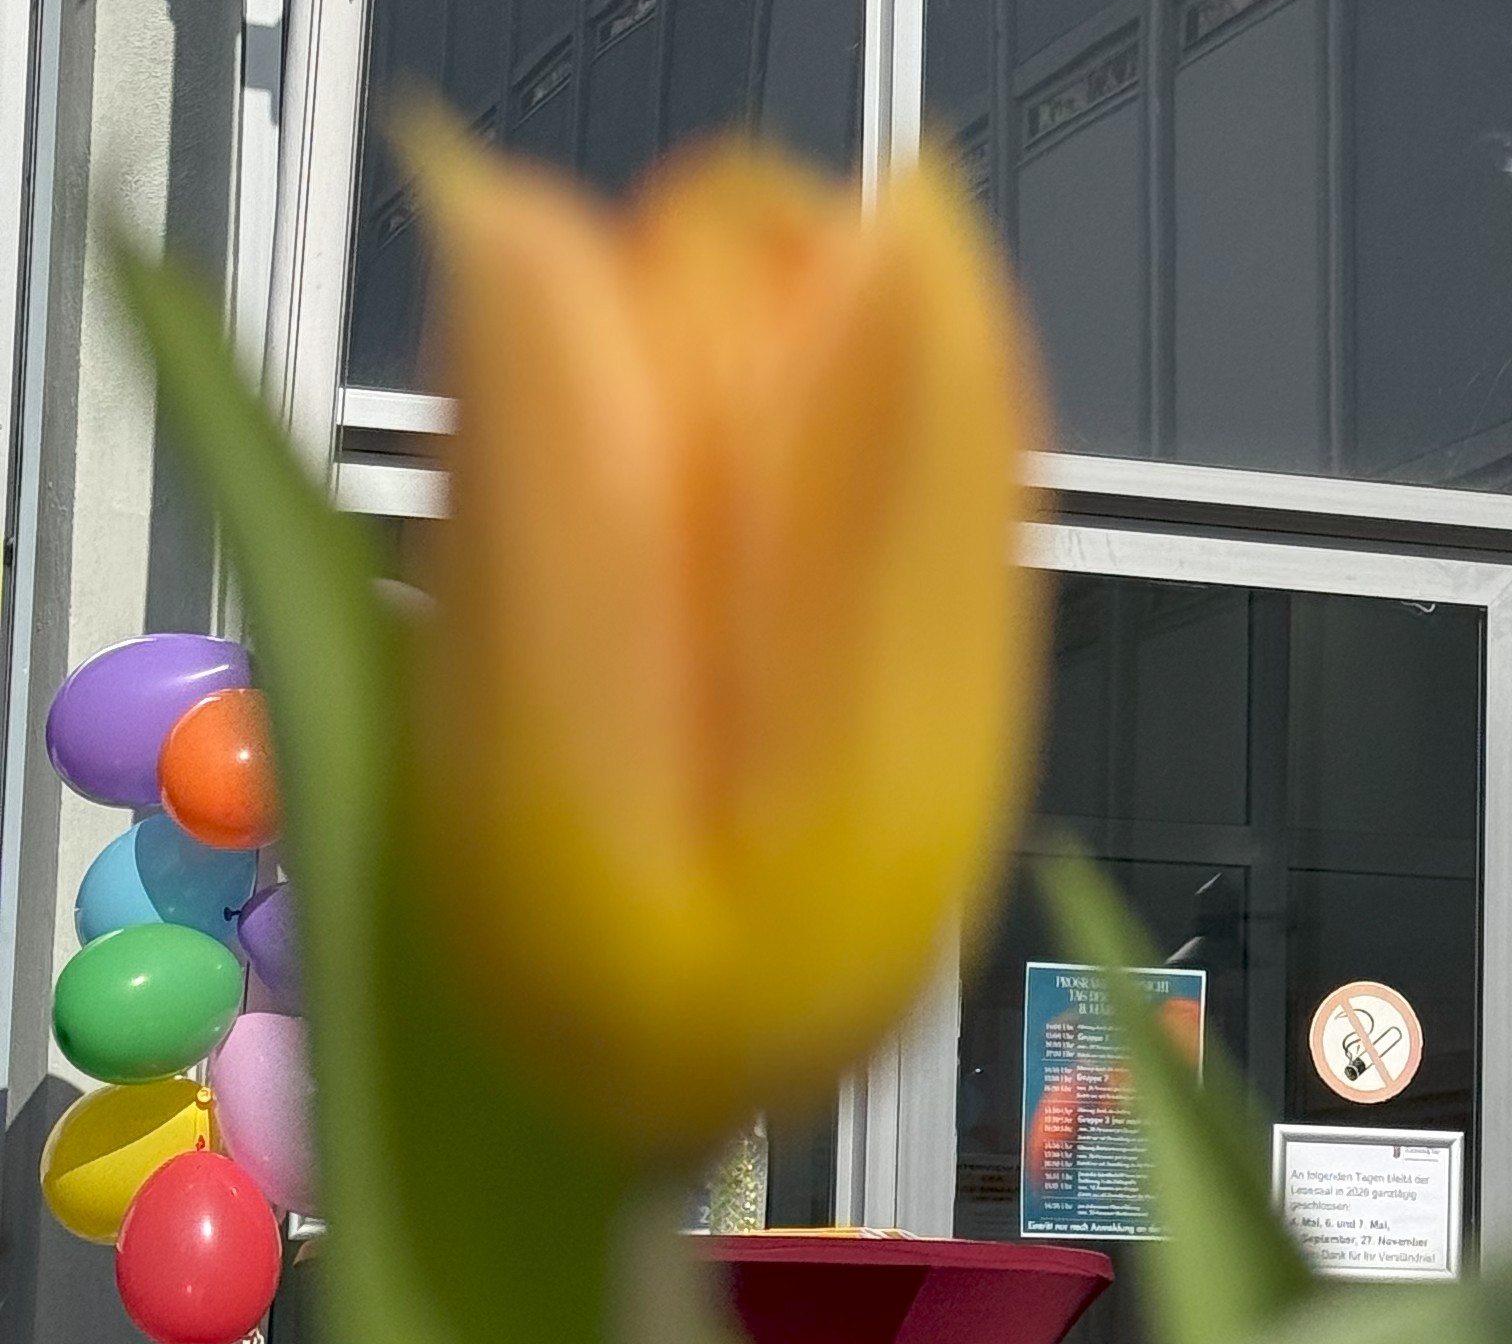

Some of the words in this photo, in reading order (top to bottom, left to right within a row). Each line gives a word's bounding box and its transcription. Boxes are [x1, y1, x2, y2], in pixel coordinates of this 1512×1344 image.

[1077, 1115, 1103, 1126] Gruppe
[1291, 1170, 1304, 1180] An
[1307, 1170, 1352, 1182] folgenden
[1355, 1172, 1384, 1184] Tagen
[1415, 1175, 1430, 1184] der
[1335, 1186, 1343, 1196] in
[1337, 1218, 1356, 1228] und
[1370, 1220, 1390, 1231] Mai,
[1378, 1236, 1427, 1247] November
[1349, 1250, 1361, 1261] für
